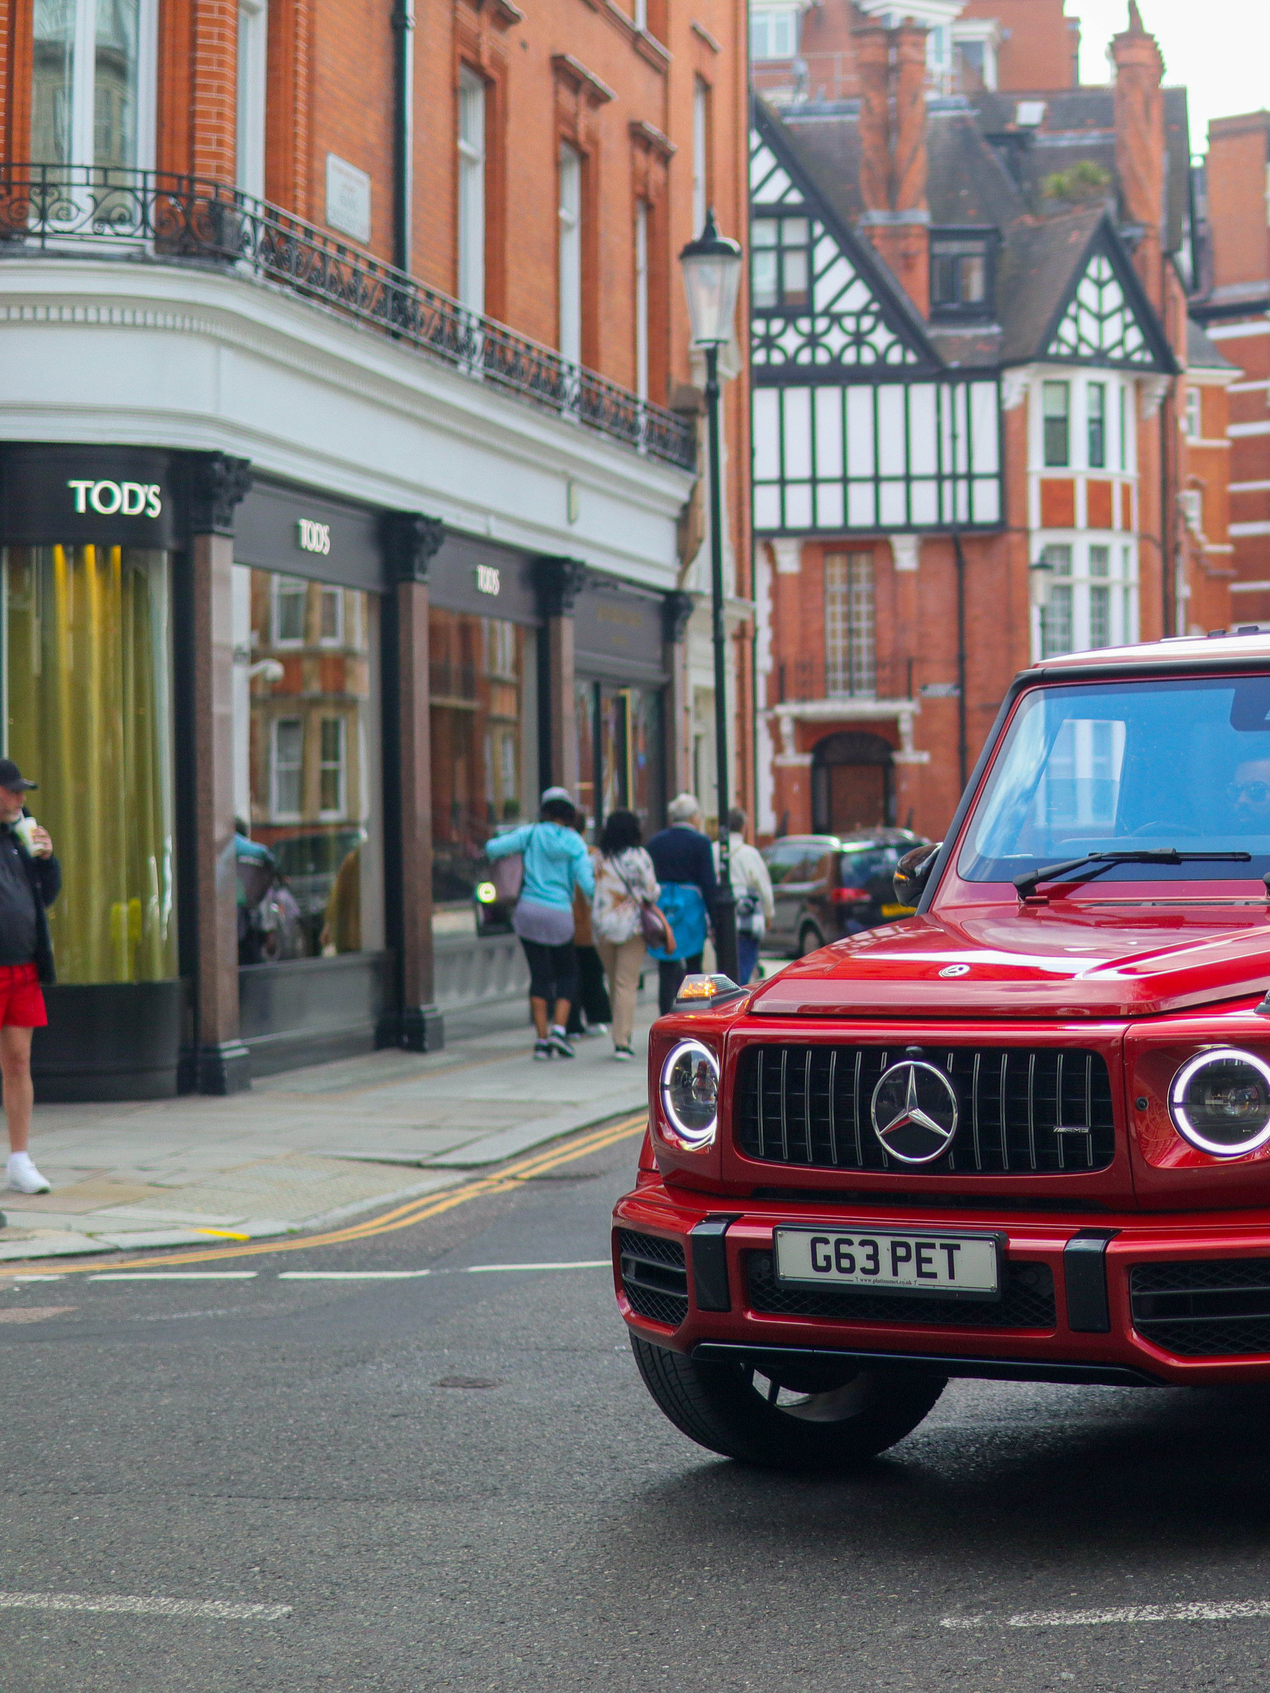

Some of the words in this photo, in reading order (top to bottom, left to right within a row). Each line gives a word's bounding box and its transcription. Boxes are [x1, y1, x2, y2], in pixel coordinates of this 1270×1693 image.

[68, 480, 161, 518] TOD'S
[810, 1236, 880, 1275] G63
[891, 1240, 961, 1280] PET
